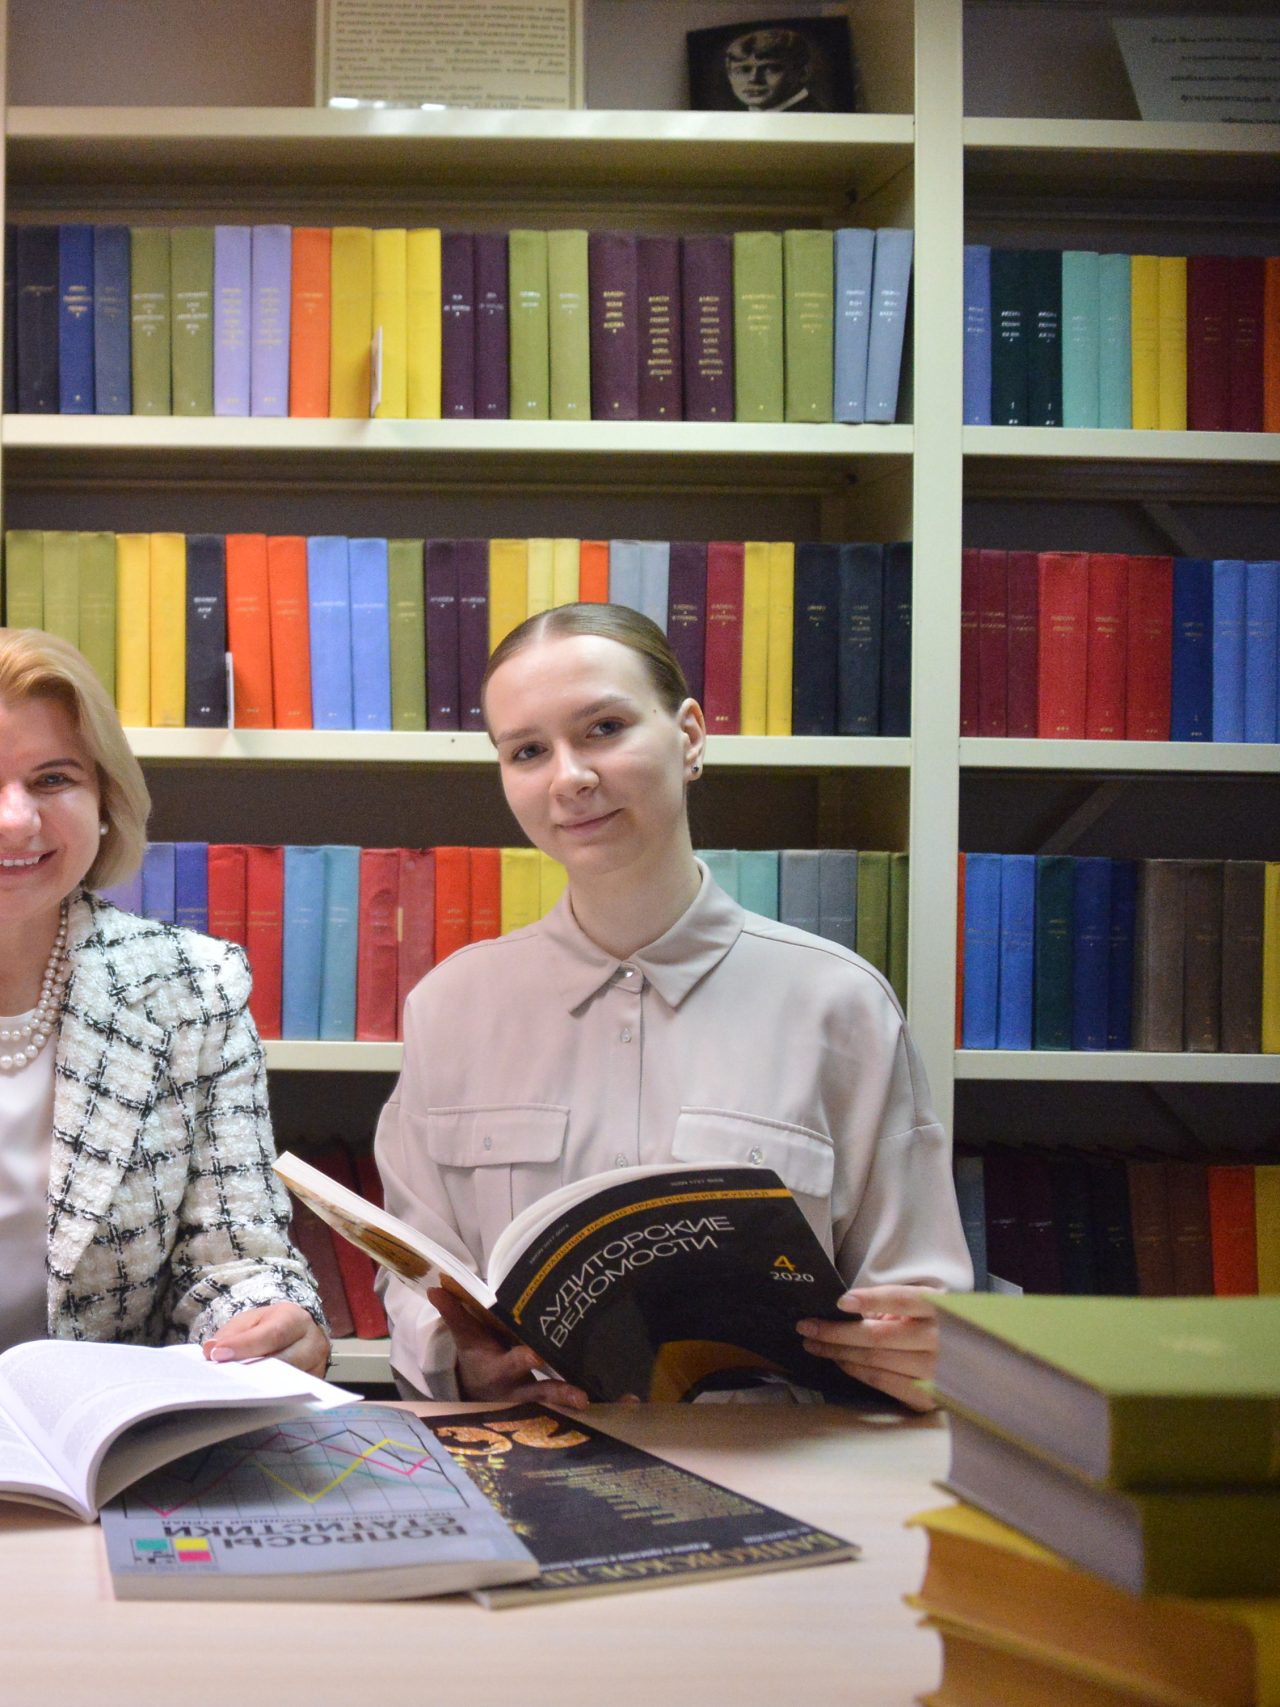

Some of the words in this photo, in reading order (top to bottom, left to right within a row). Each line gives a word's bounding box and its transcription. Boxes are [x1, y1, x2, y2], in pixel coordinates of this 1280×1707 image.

[720, 1189, 768, 1198] ЖУРНАЛ
[773, 1254, 796, 1271] 4
[539, 1216, 735, 1336] АУДИТОРСКИЕ
[769, 1270, 815, 1283] 2020
[550, 1235, 718, 1348] ВЕДОМОСТИ
[163, 1516, 456, 1538] СТАТИСТИКИ
[223, 1524, 467, 1550] ВОПРОСЫ
